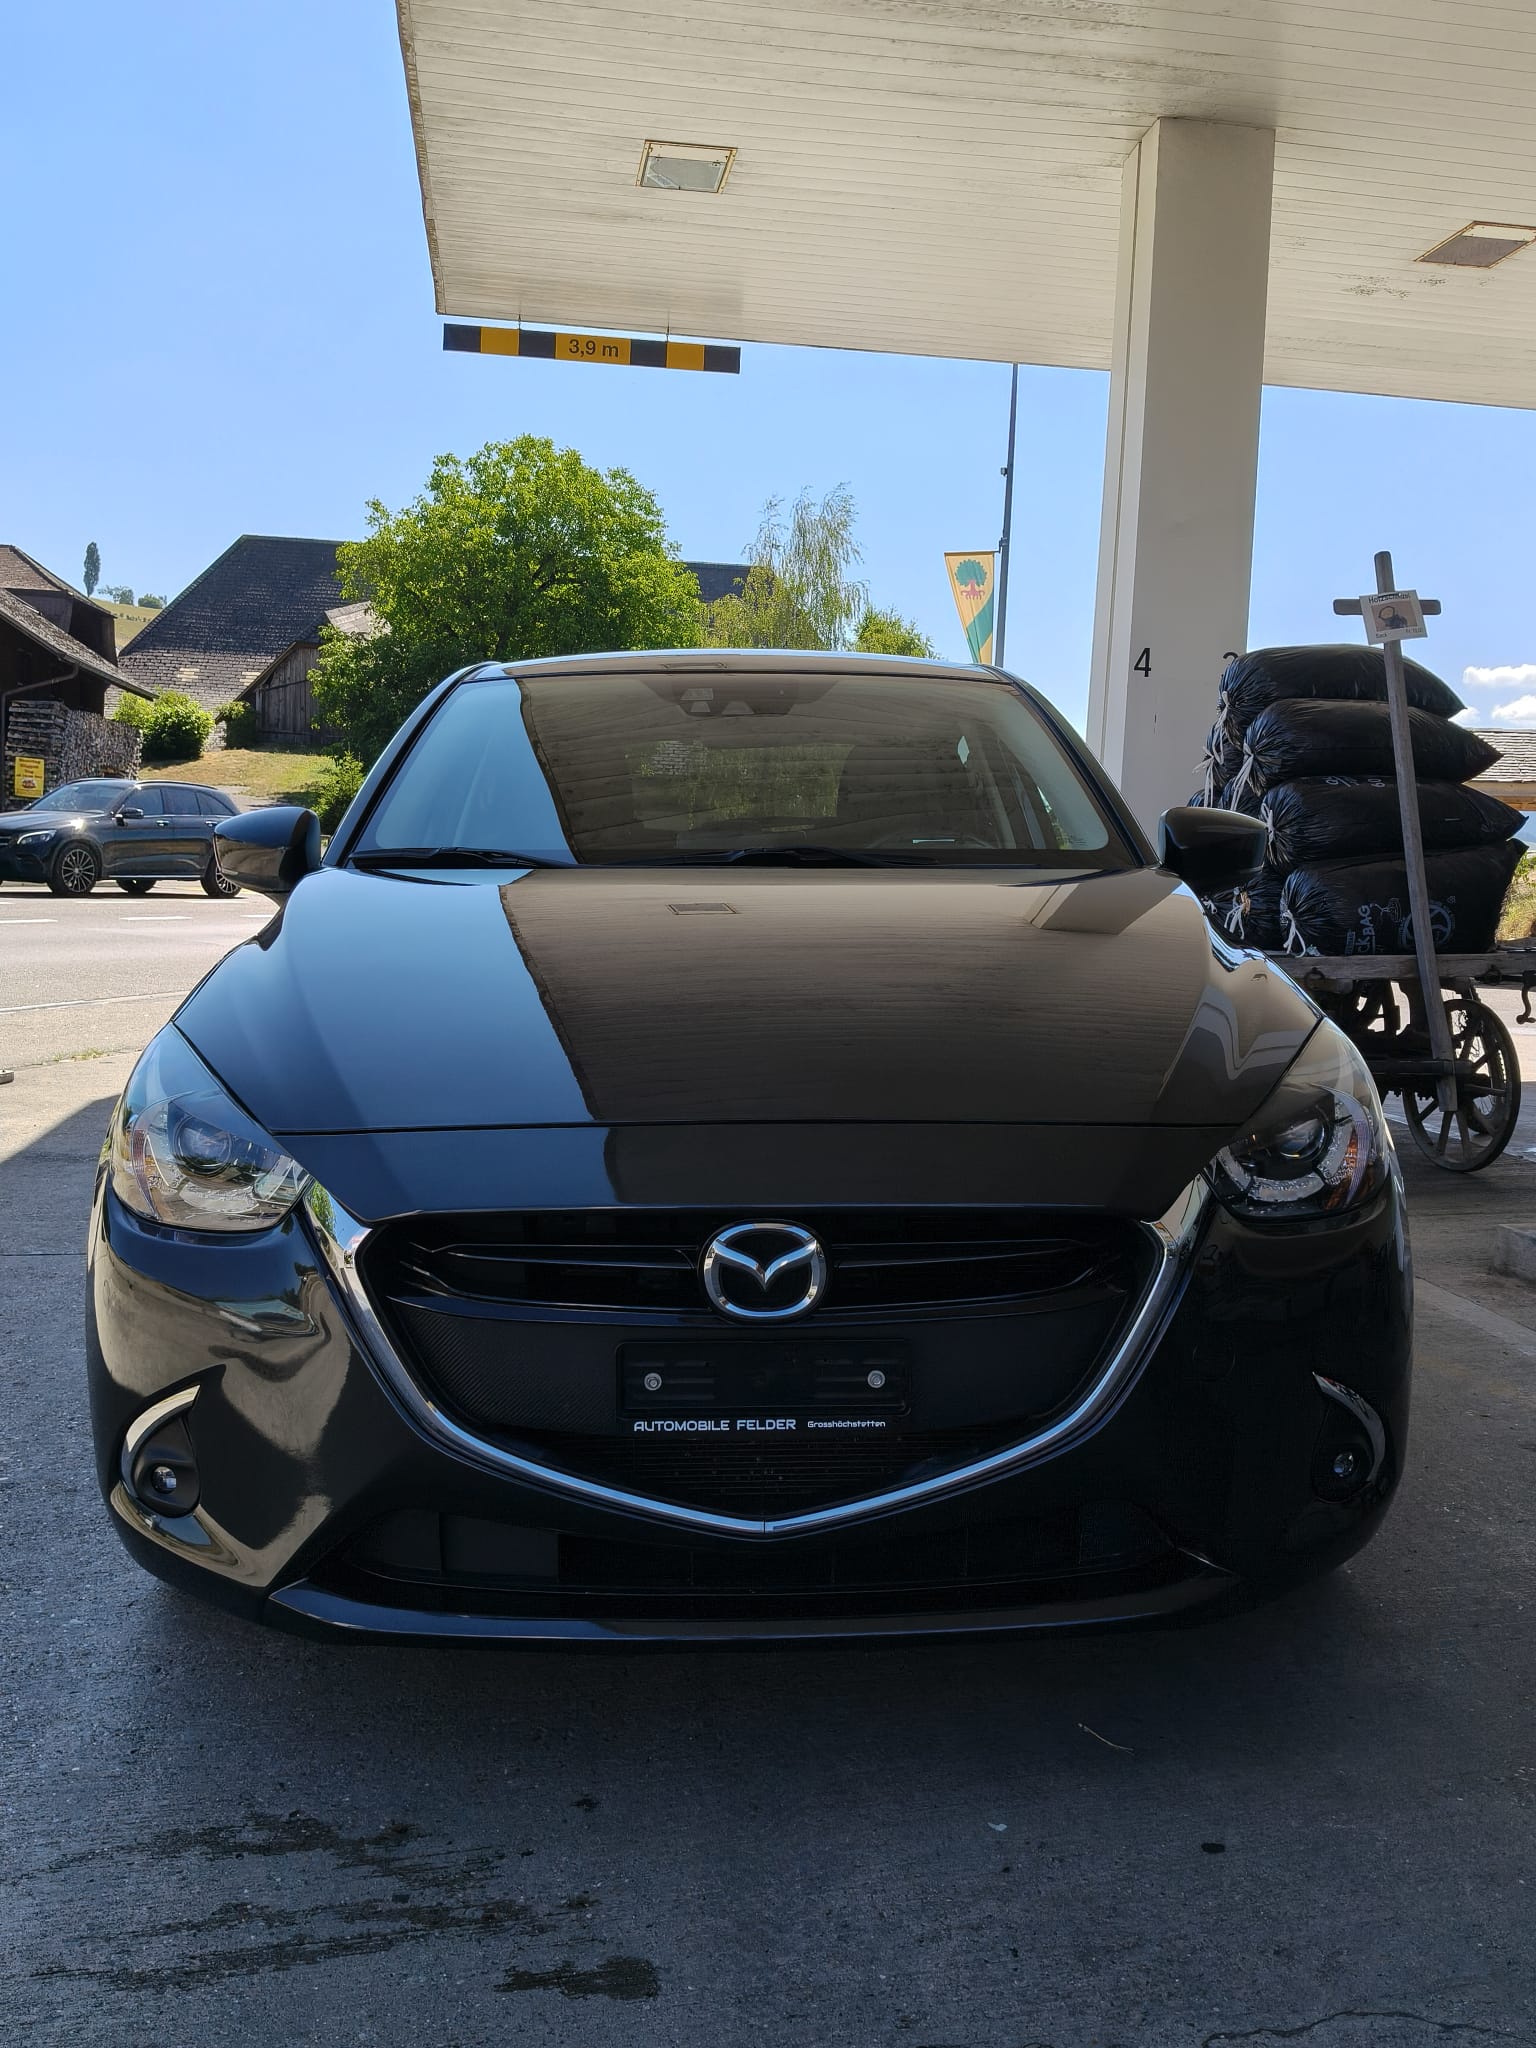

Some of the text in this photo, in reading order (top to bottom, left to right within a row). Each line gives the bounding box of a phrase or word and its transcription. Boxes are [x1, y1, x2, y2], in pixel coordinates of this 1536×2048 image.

[568, 339, 619, 358] 3,9 m
[1133, 647, 1152, 678] 4
[633, 1419, 886, 1432] AUTOMOBILE FELDER Grosshöchstetten
